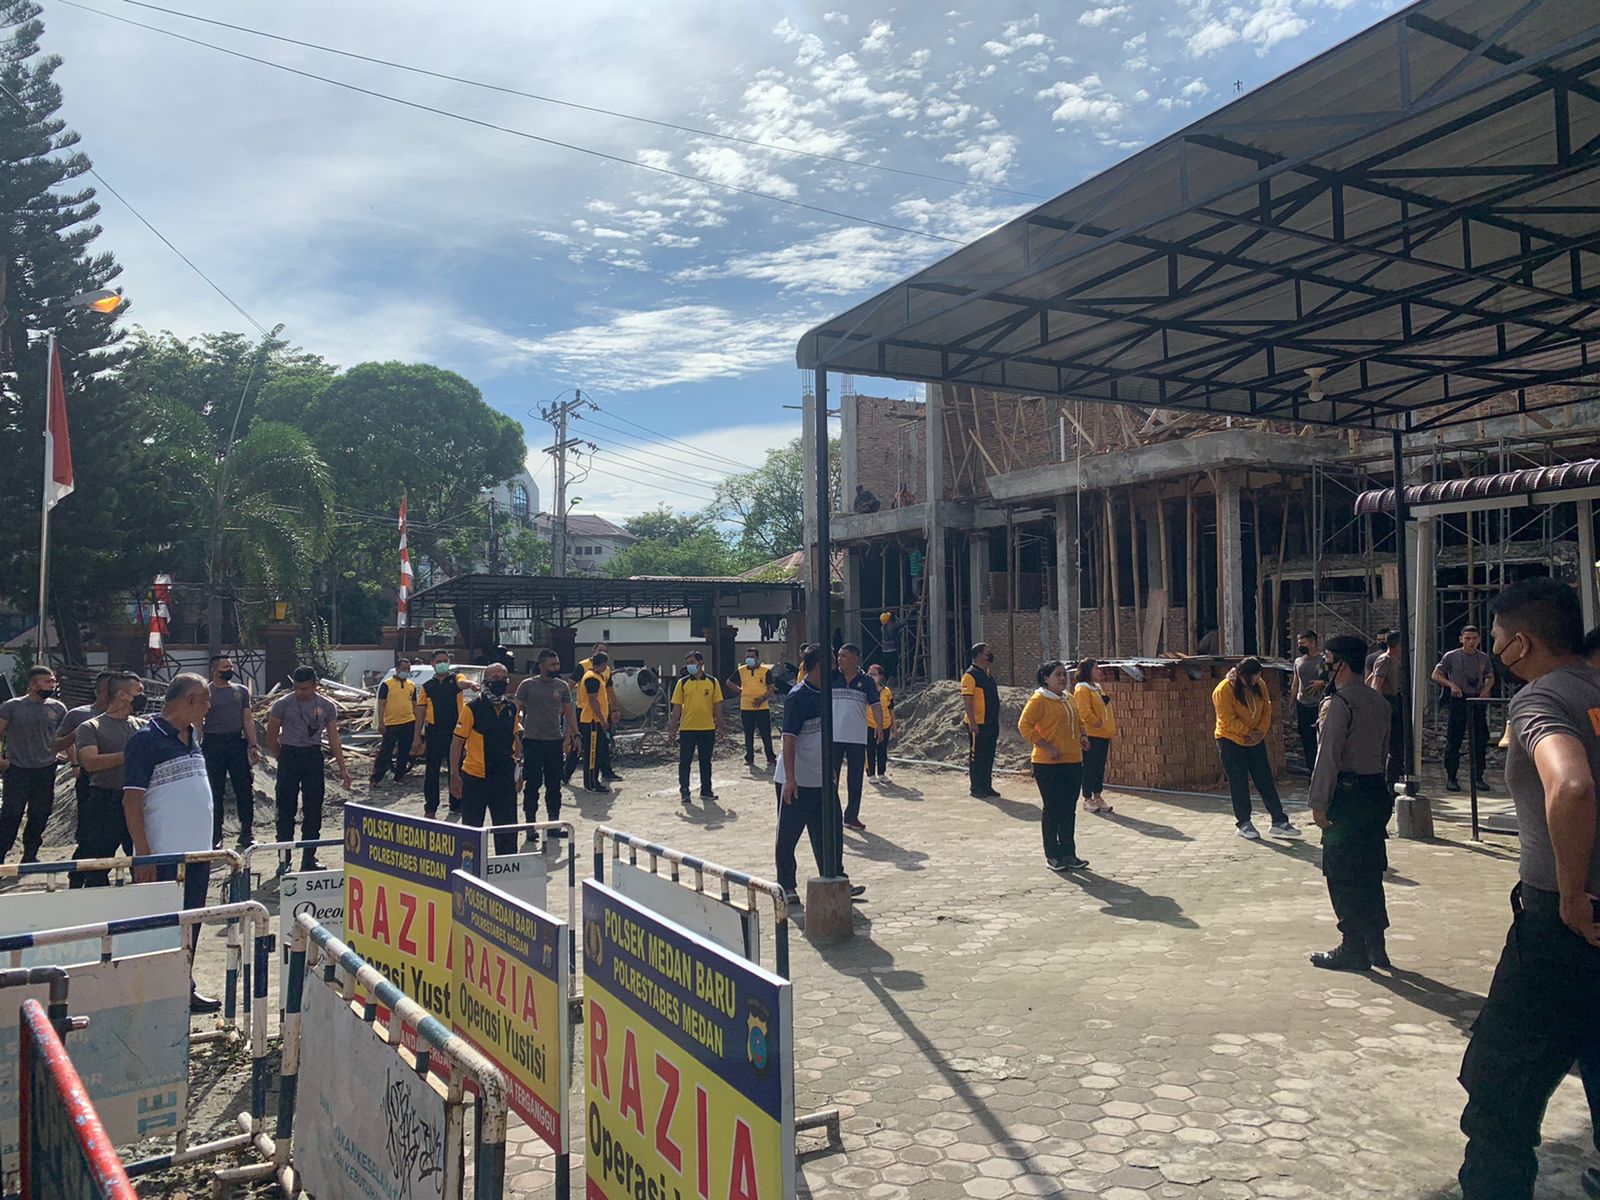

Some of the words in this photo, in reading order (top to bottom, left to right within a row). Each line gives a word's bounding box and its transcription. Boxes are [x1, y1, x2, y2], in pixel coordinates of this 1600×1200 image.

[363, 817, 394, 842] POLSEK
[396, 823, 427, 849] MEDAN
[429, 831, 456, 857] BARU
[369, 845, 418, 873] POLRESTABES
[419, 858, 447, 881] MEDAN
[346, 875, 453, 972] RAZI
[464, 886, 488, 914] POLSEK
[489, 899, 514, 928] MEDAN
[515, 913, 537, 941] BARU
[471, 912, 506, 944] POLRESTABES
[507, 932, 529, 957] MEDAN
[463, 934, 539, 1032] RAZIA
[604, 908, 646, 962] POLSEK
[649, 932, 692, 991] MEDAN
[696, 960, 736, 1019] BARU
[613, 956, 680, 1026] POLRESTABES
[682, 1002, 724, 1058] MEDAN
[459, 982, 501, 1046] Operasi
[503, 1015, 547, 1084] Yustisi
[514, 1083, 556, 1136] TERGANGGU
[589, 998, 760, 1200] RAZIA
